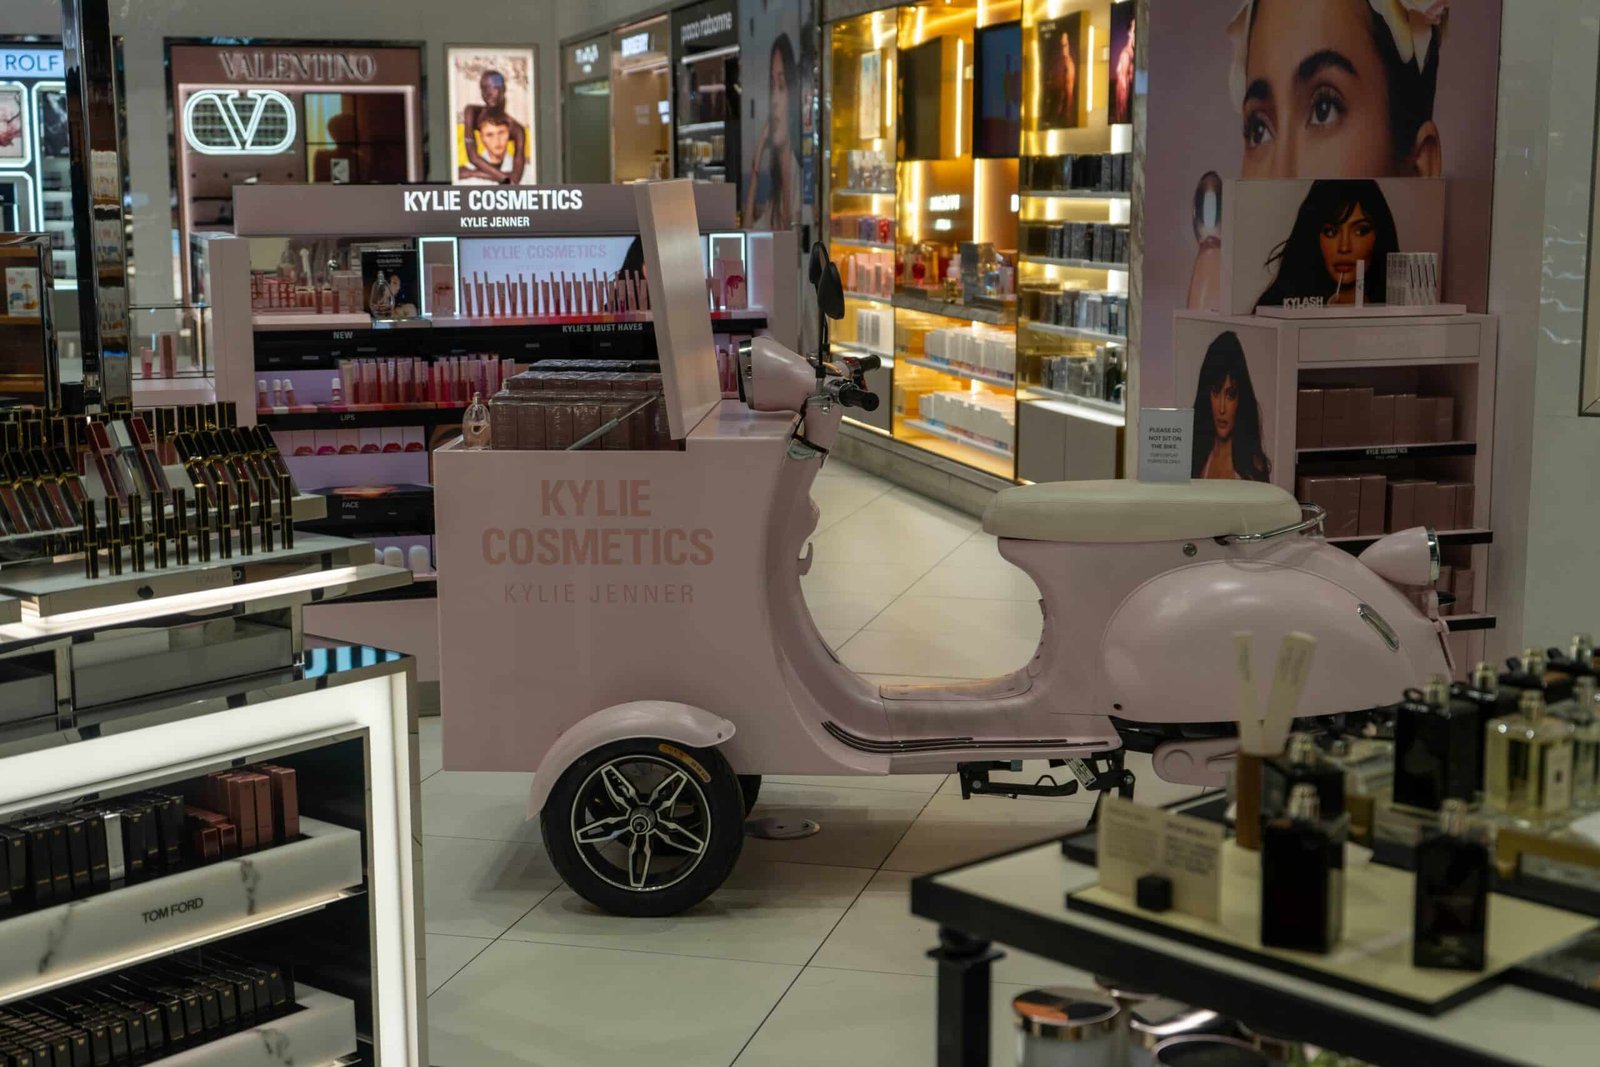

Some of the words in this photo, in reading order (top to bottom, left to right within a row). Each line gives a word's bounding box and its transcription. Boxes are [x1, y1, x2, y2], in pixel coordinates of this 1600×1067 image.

[5, 54, 59, 71] ROLF
[218, 51, 377, 82] VALENTINO
[404, 190, 461, 211] KYLIE
[468, 189, 583, 211] COSMETICS
[460, 216, 488, 228] KYLIE
[490, 216, 530, 228] JENNER
[482, 244, 521, 260] KYLIE
[527, 243, 607, 259] COSMETICS
[1283, 296, 1324, 310] KYLASH
[333, 331, 354, 340] NEW
[562, 324, 592, 333] KYLIE'S
[593, 323, 616, 332] MUST
[618, 322, 643, 331] HAVES
[340, 414, 356, 422] LIPS
[341, 500, 360, 509] FACE
[540, 479, 651, 517] KYLIE
[481, 527, 714, 566] COSMETICS
[504, 584, 575, 603] KYLIE
[589, 584, 694, 603] JENNER
[141, 906, 169, 924] TOM
[170, 897, 204, 916] FORD
